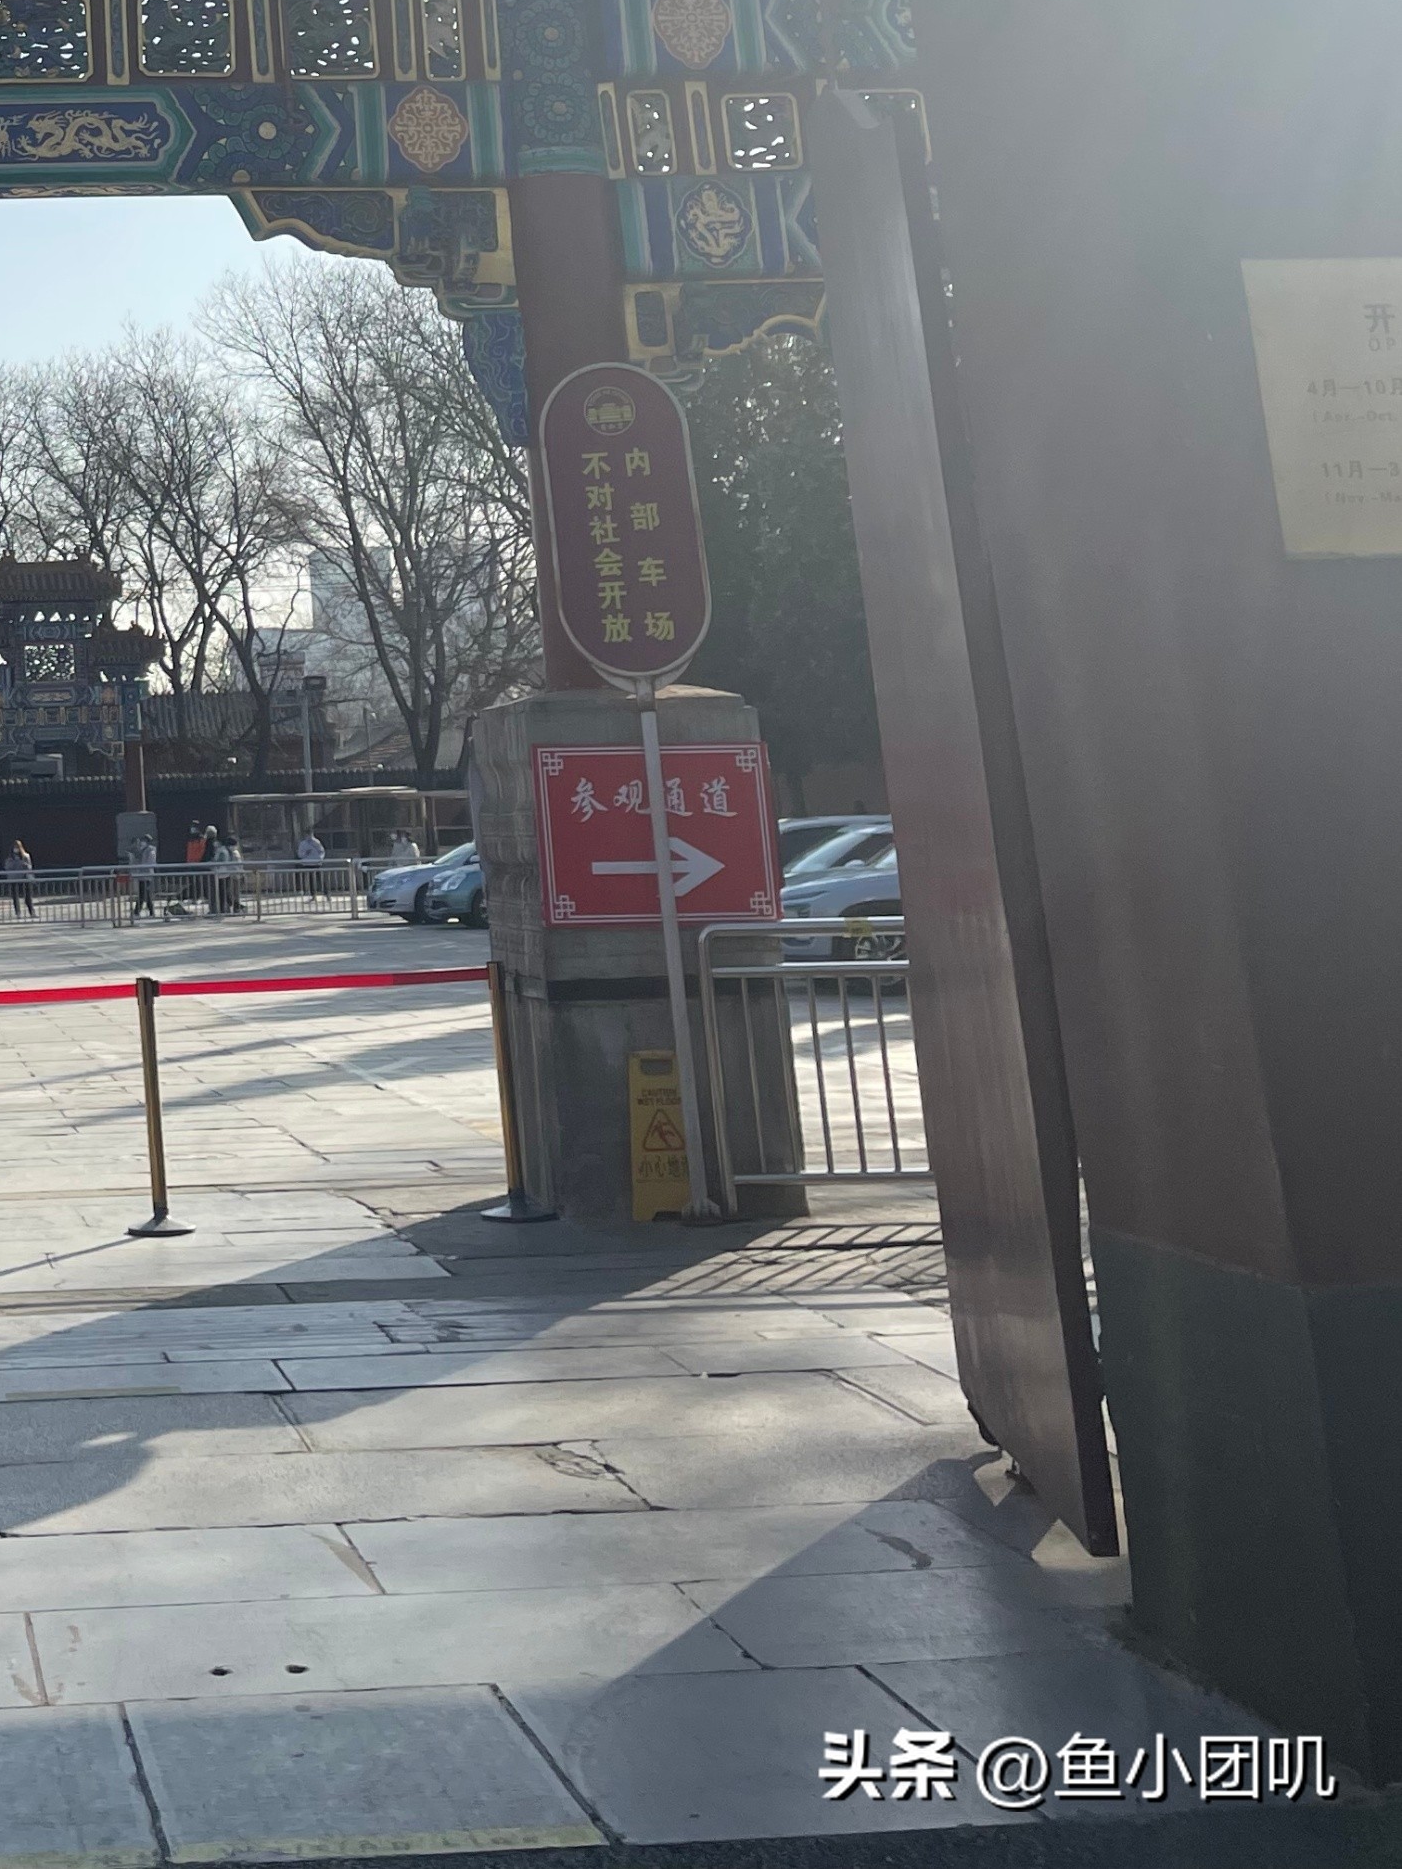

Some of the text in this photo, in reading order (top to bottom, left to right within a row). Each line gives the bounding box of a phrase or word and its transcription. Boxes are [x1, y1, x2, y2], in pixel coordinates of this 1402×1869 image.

[582, 451, 633, 644] 不对社会开放
[625, 447, 675, 641] 内部车场
[571, 776, 738, 823] 参观通道
